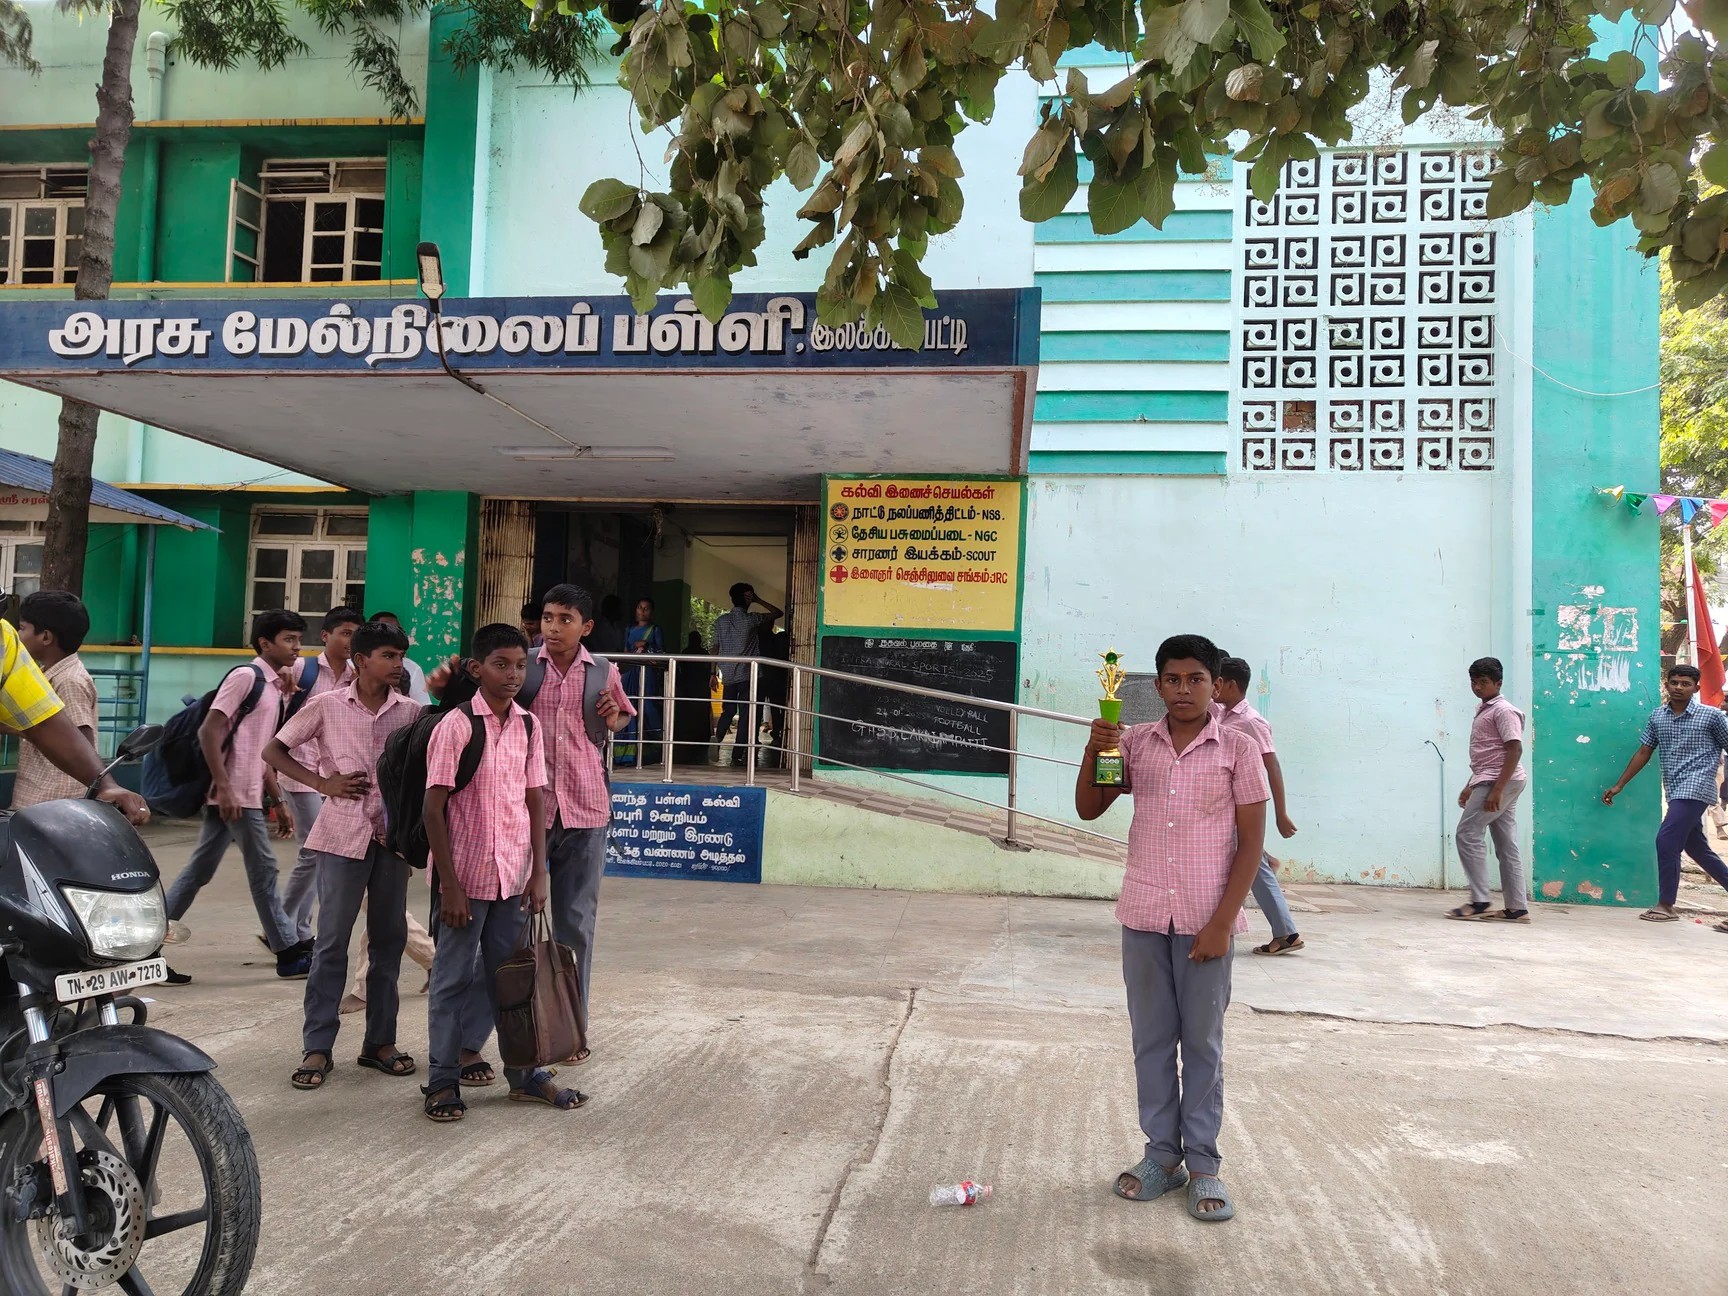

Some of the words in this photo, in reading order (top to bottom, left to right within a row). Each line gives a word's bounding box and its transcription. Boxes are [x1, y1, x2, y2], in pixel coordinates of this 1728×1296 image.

[48, 311, 212, 365] அரசு
[222, 303, 600, 367] மேல்நிலைப்
[841, 483, 881, 498] கல்வி
[851, 505, 885, 522] நாட்டு
[851, 526, 887, 542] தேசிய
[974, 530, 998, 542] NGC
[852, 546, 898, 562] சாரணர்
[850, 566, 892, 582] இளைஞர்
[912, 660, 955, 675] SPORTS
[655, 792, 691, 805] பள்ளி
[702, 795, 741, 808] கல்வி
[650, 809, 708, 826] ஒன்றியம்
[642, 825, 676, 843] மற்றும்
[685, 826, 734, 847] இரண்டு
[700, 847, 746, 866] அடித்தல்
[110, 871, 151, 881] HONDA
